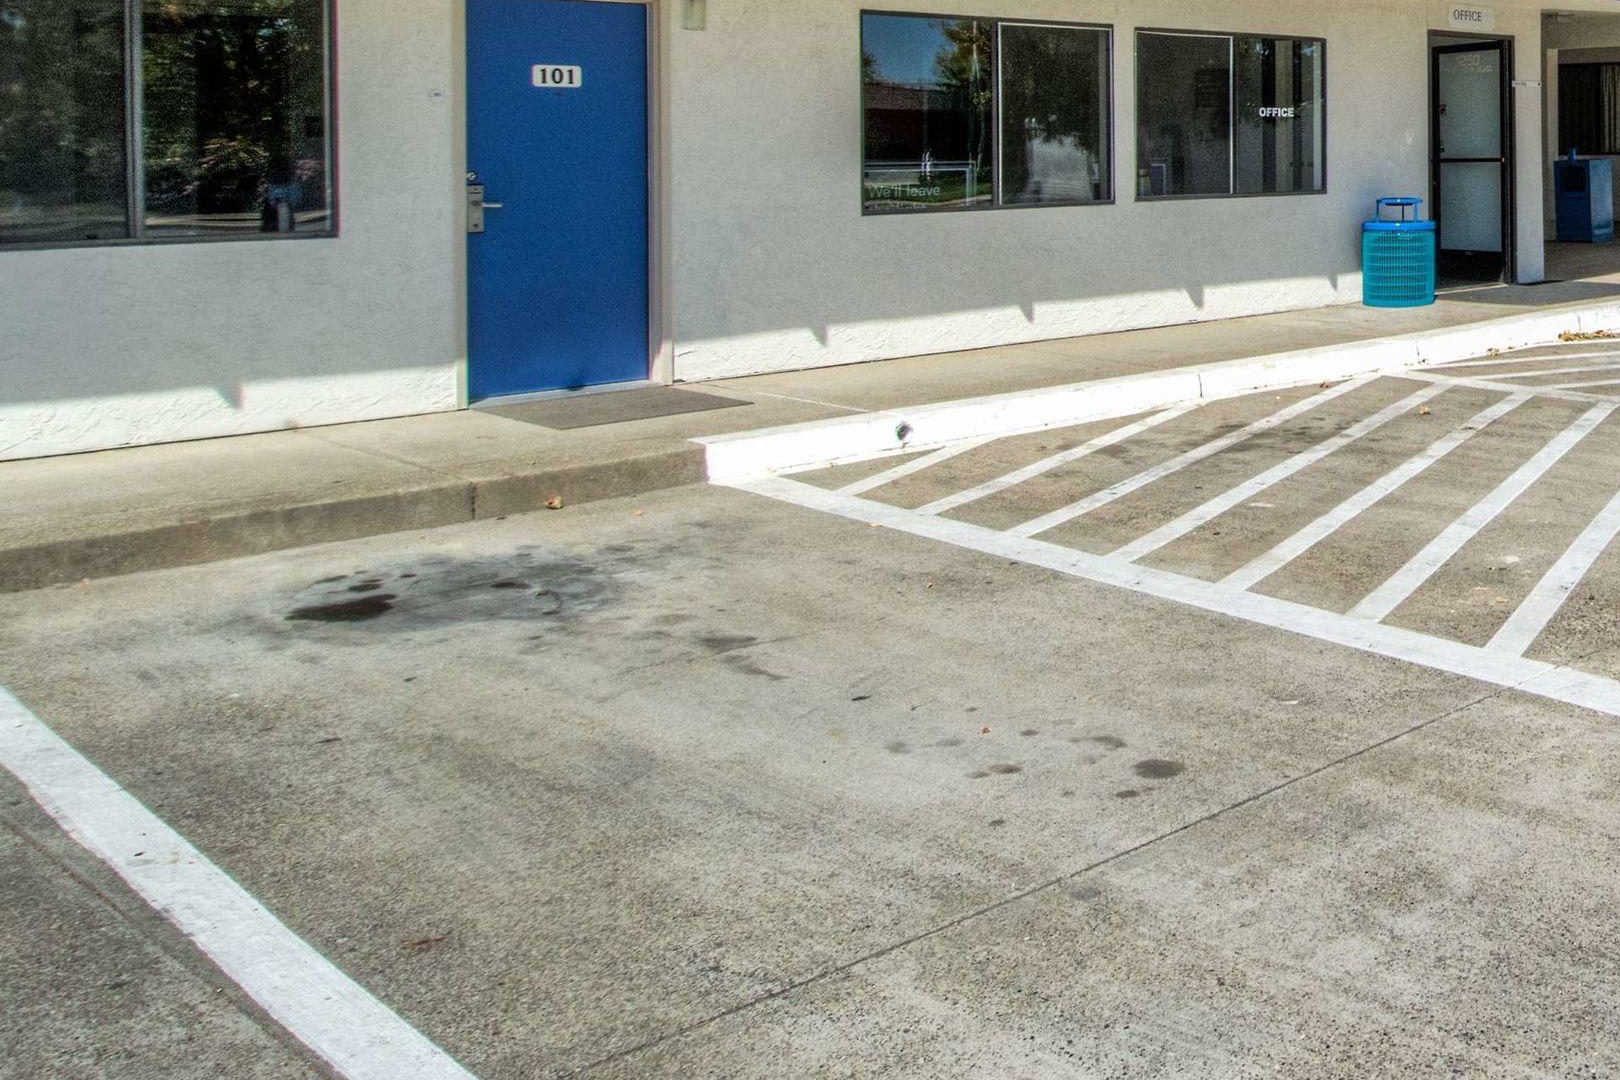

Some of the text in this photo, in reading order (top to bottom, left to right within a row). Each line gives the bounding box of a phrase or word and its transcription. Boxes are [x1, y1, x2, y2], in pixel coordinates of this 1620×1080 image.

[1452, 9, 1483, 21] OFFICE
[540, 67, 575, 85] 101
[1259, 107, 1294, 117] OFFICE
[906, 182, 941, 197] leave
